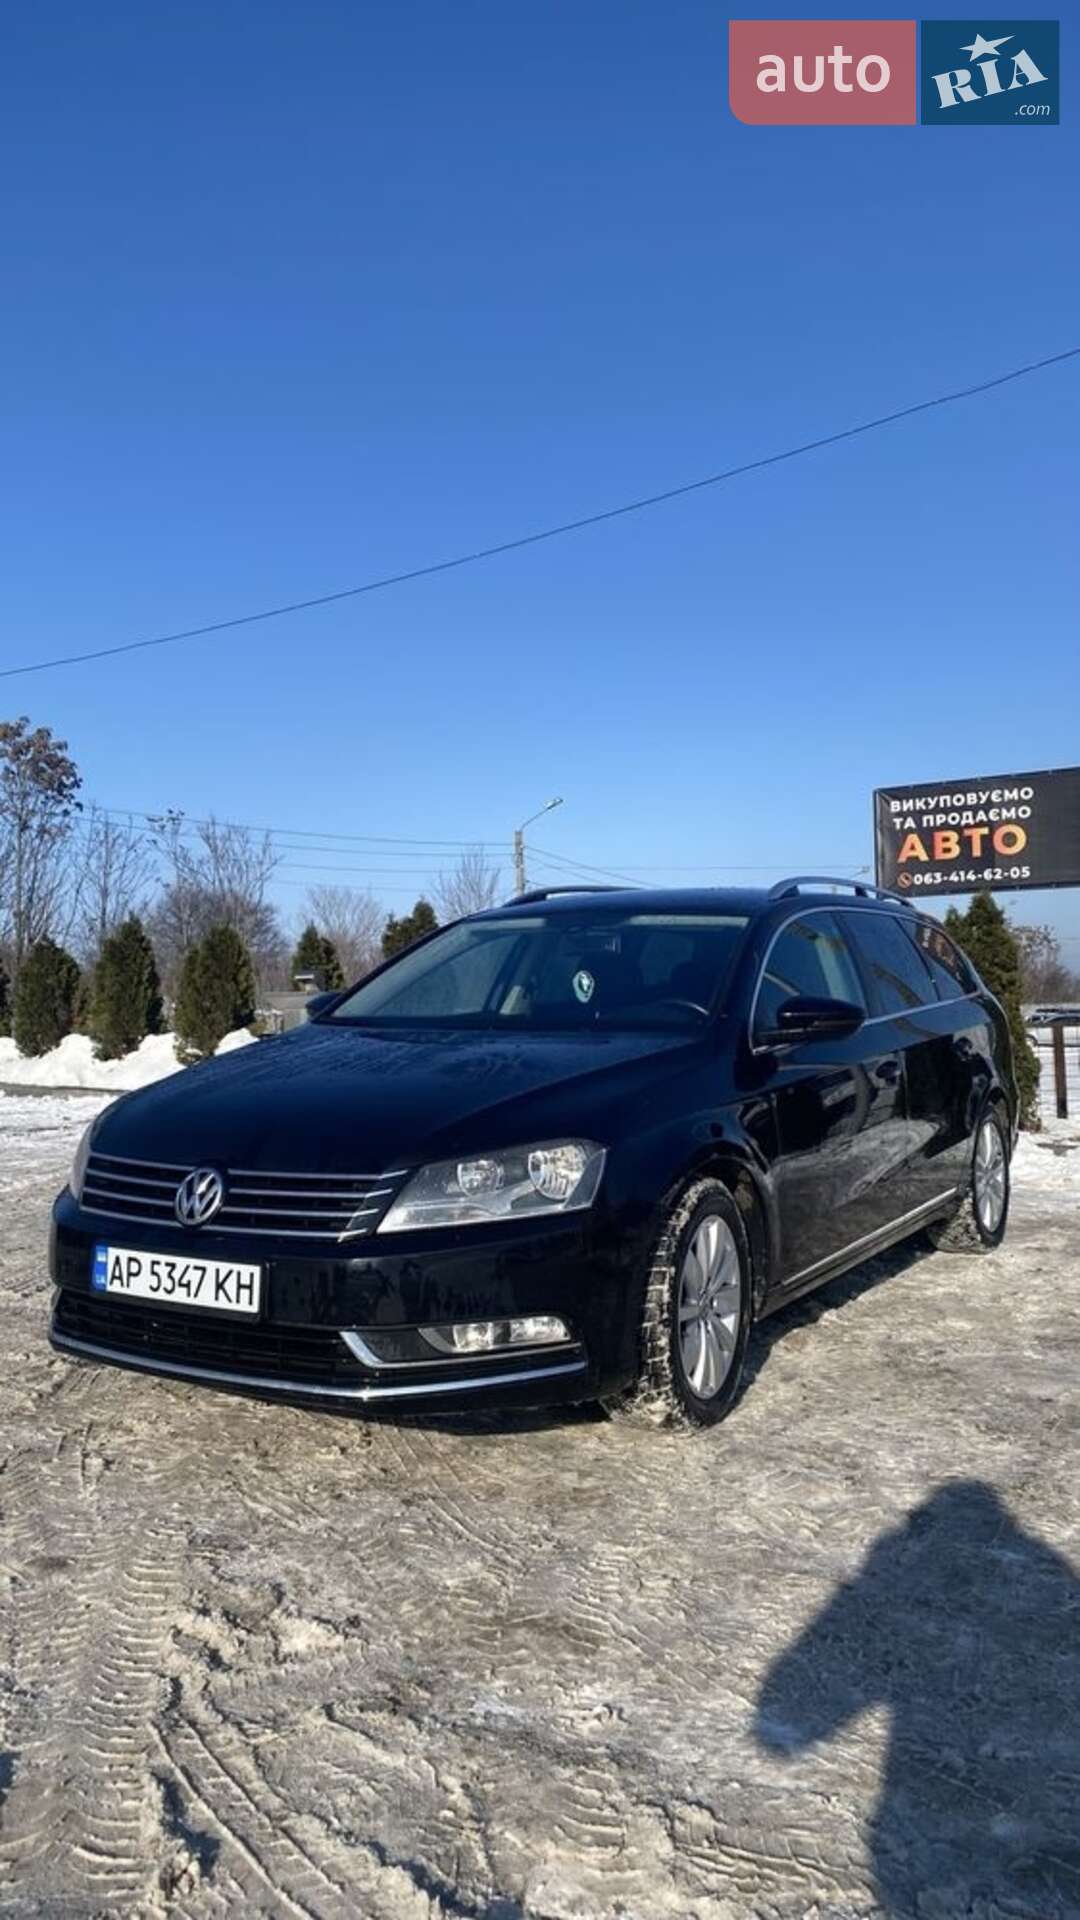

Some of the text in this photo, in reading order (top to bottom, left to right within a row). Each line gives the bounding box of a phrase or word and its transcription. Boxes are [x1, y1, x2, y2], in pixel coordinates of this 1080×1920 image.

[890, 787, 1034, 813] ВИКУПОВУЄМО
[893, 806, 1031, 830] ТА ПРОДАЄМО
[897, 823, 1027, 863] АВТО
[913, 866, 1031, 885] 063-414-62-05
[109, 1255, 255, 1306] AP 5347 KH
